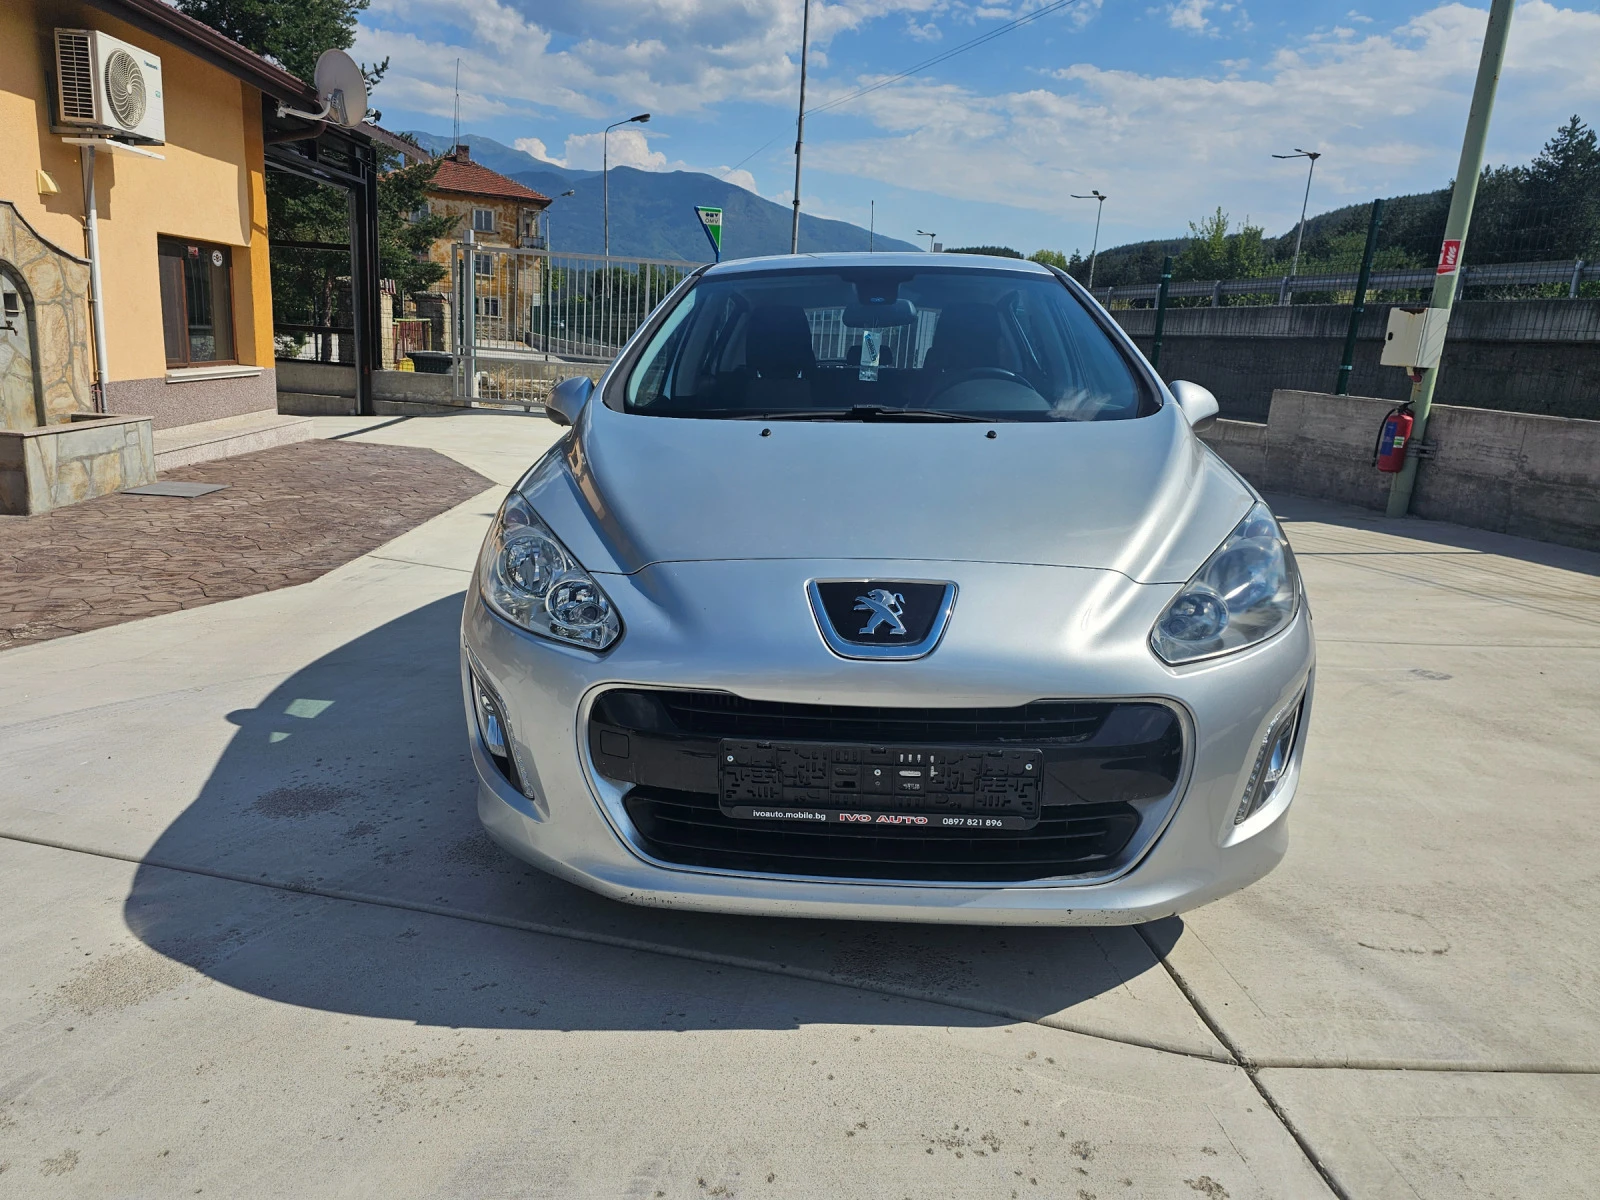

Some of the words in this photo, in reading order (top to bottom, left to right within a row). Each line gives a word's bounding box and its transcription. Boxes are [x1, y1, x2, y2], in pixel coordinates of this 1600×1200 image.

[752, 809, 826, 821] ivoauto.mobile.bg
[839, 813, 871, 822] IVO
[875, 814, 928, 824] AUTO
[942, 817, 964, 826] 0897
[967, 818, 982, 826] 821
[985, 819, 1002, 827] 896
